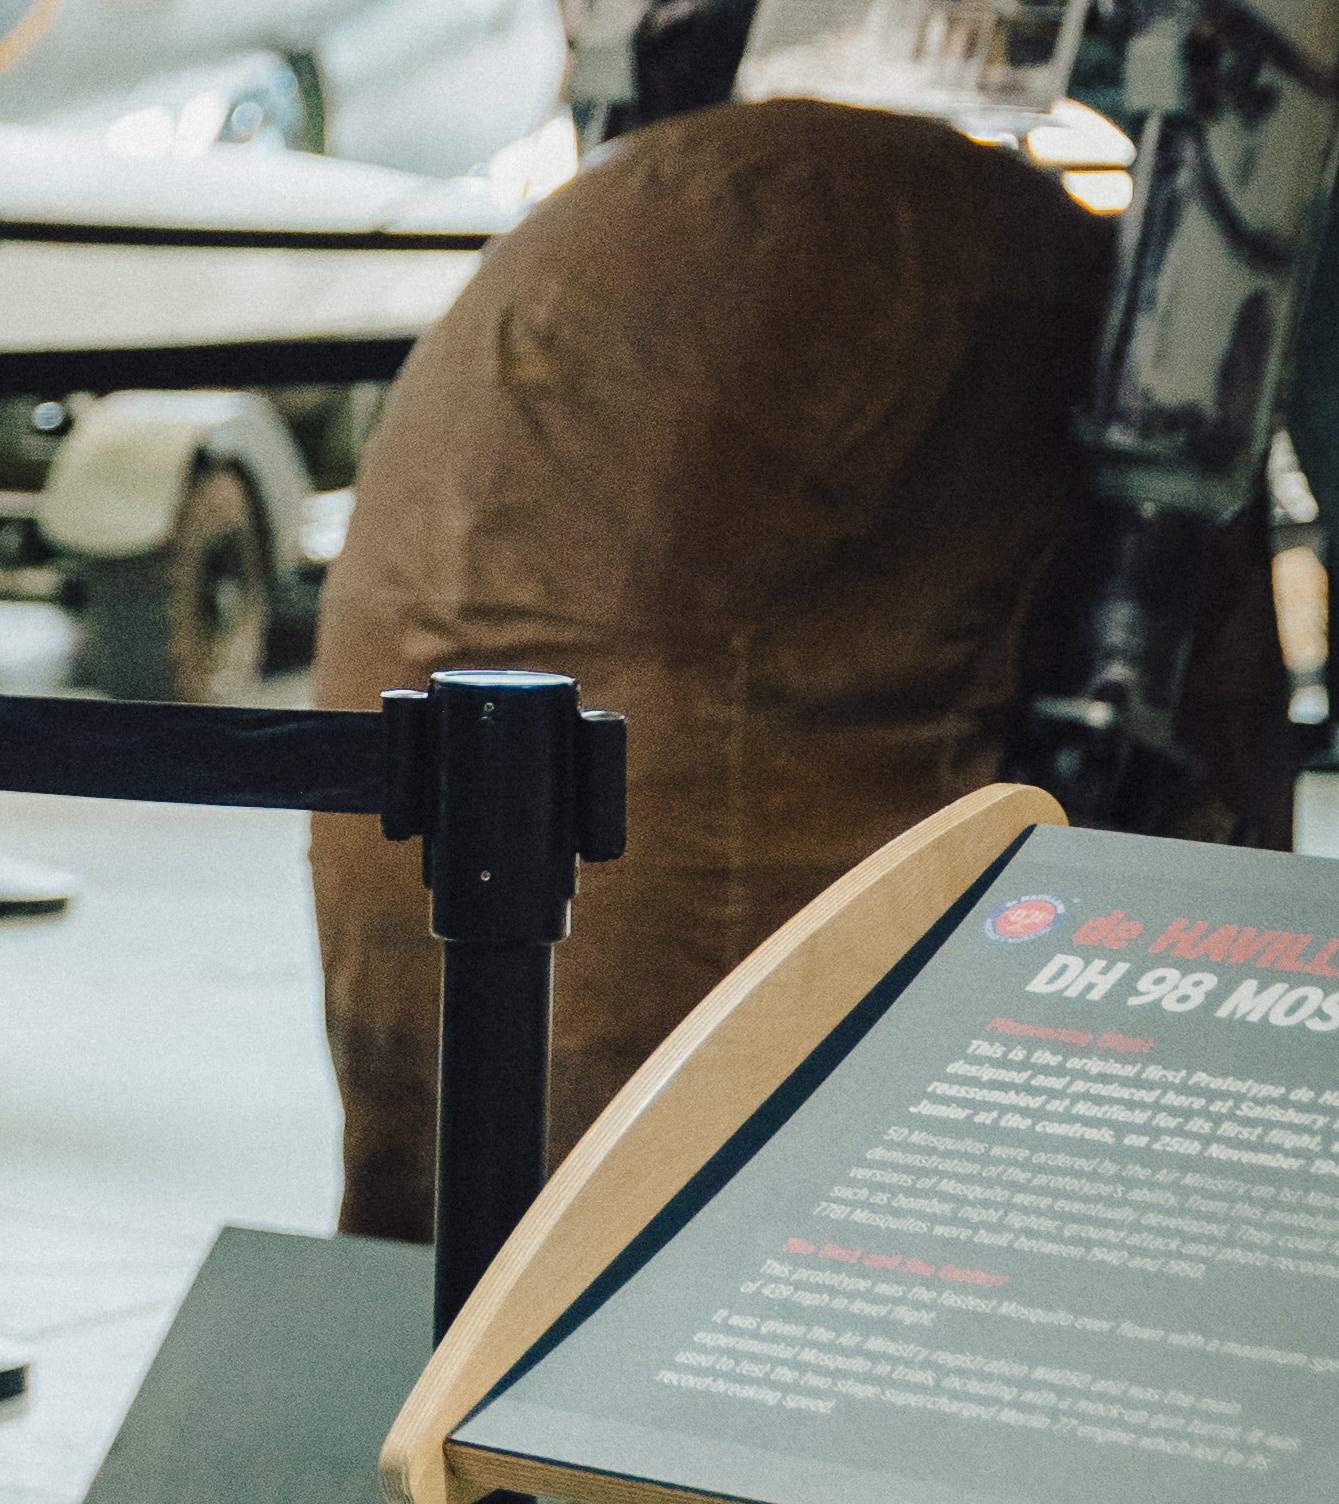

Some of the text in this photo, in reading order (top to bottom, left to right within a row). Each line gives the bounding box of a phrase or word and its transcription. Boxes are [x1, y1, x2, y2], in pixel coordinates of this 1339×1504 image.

[1073, 911, 1143, 949] de
[1149, 918, 1339, 977] HAVILL
[1025, 954, 1131, 1001] DH
[1127, 968, 1218, 1012] 98
[945, 1059, 1031, 1083] designed
[1029, 1073, 1071, 1090] and
[1067, 1079, 1161, 1102] produced
[1159, 1089, 1206, 1109] here
[1207, 1098, 1234, 1113] at
[1236, 1100, 1329, 1128] Salisbury
[966, 1038, 1339, 1107] This is the original first Prototype de H
[908, 1099, 971, 1119] Junior
[972, 1109, 999, 1125] at
[998, 1112, 1032, 1130] the
[1122, 1133, 1150, 1147] on
[1151, 1135, 1201, 1155] 25th
[1204, 1143, 1304, 1170] November
[927, 1081, 1045, 1108] reassembled
[1044, 1097, 1070, 1112] at
[1071, 1100, 1151, 1124] Hatfield
[1150, 1111, 1183, 1129] for
[1216, 1120, 1263, 1141] first
